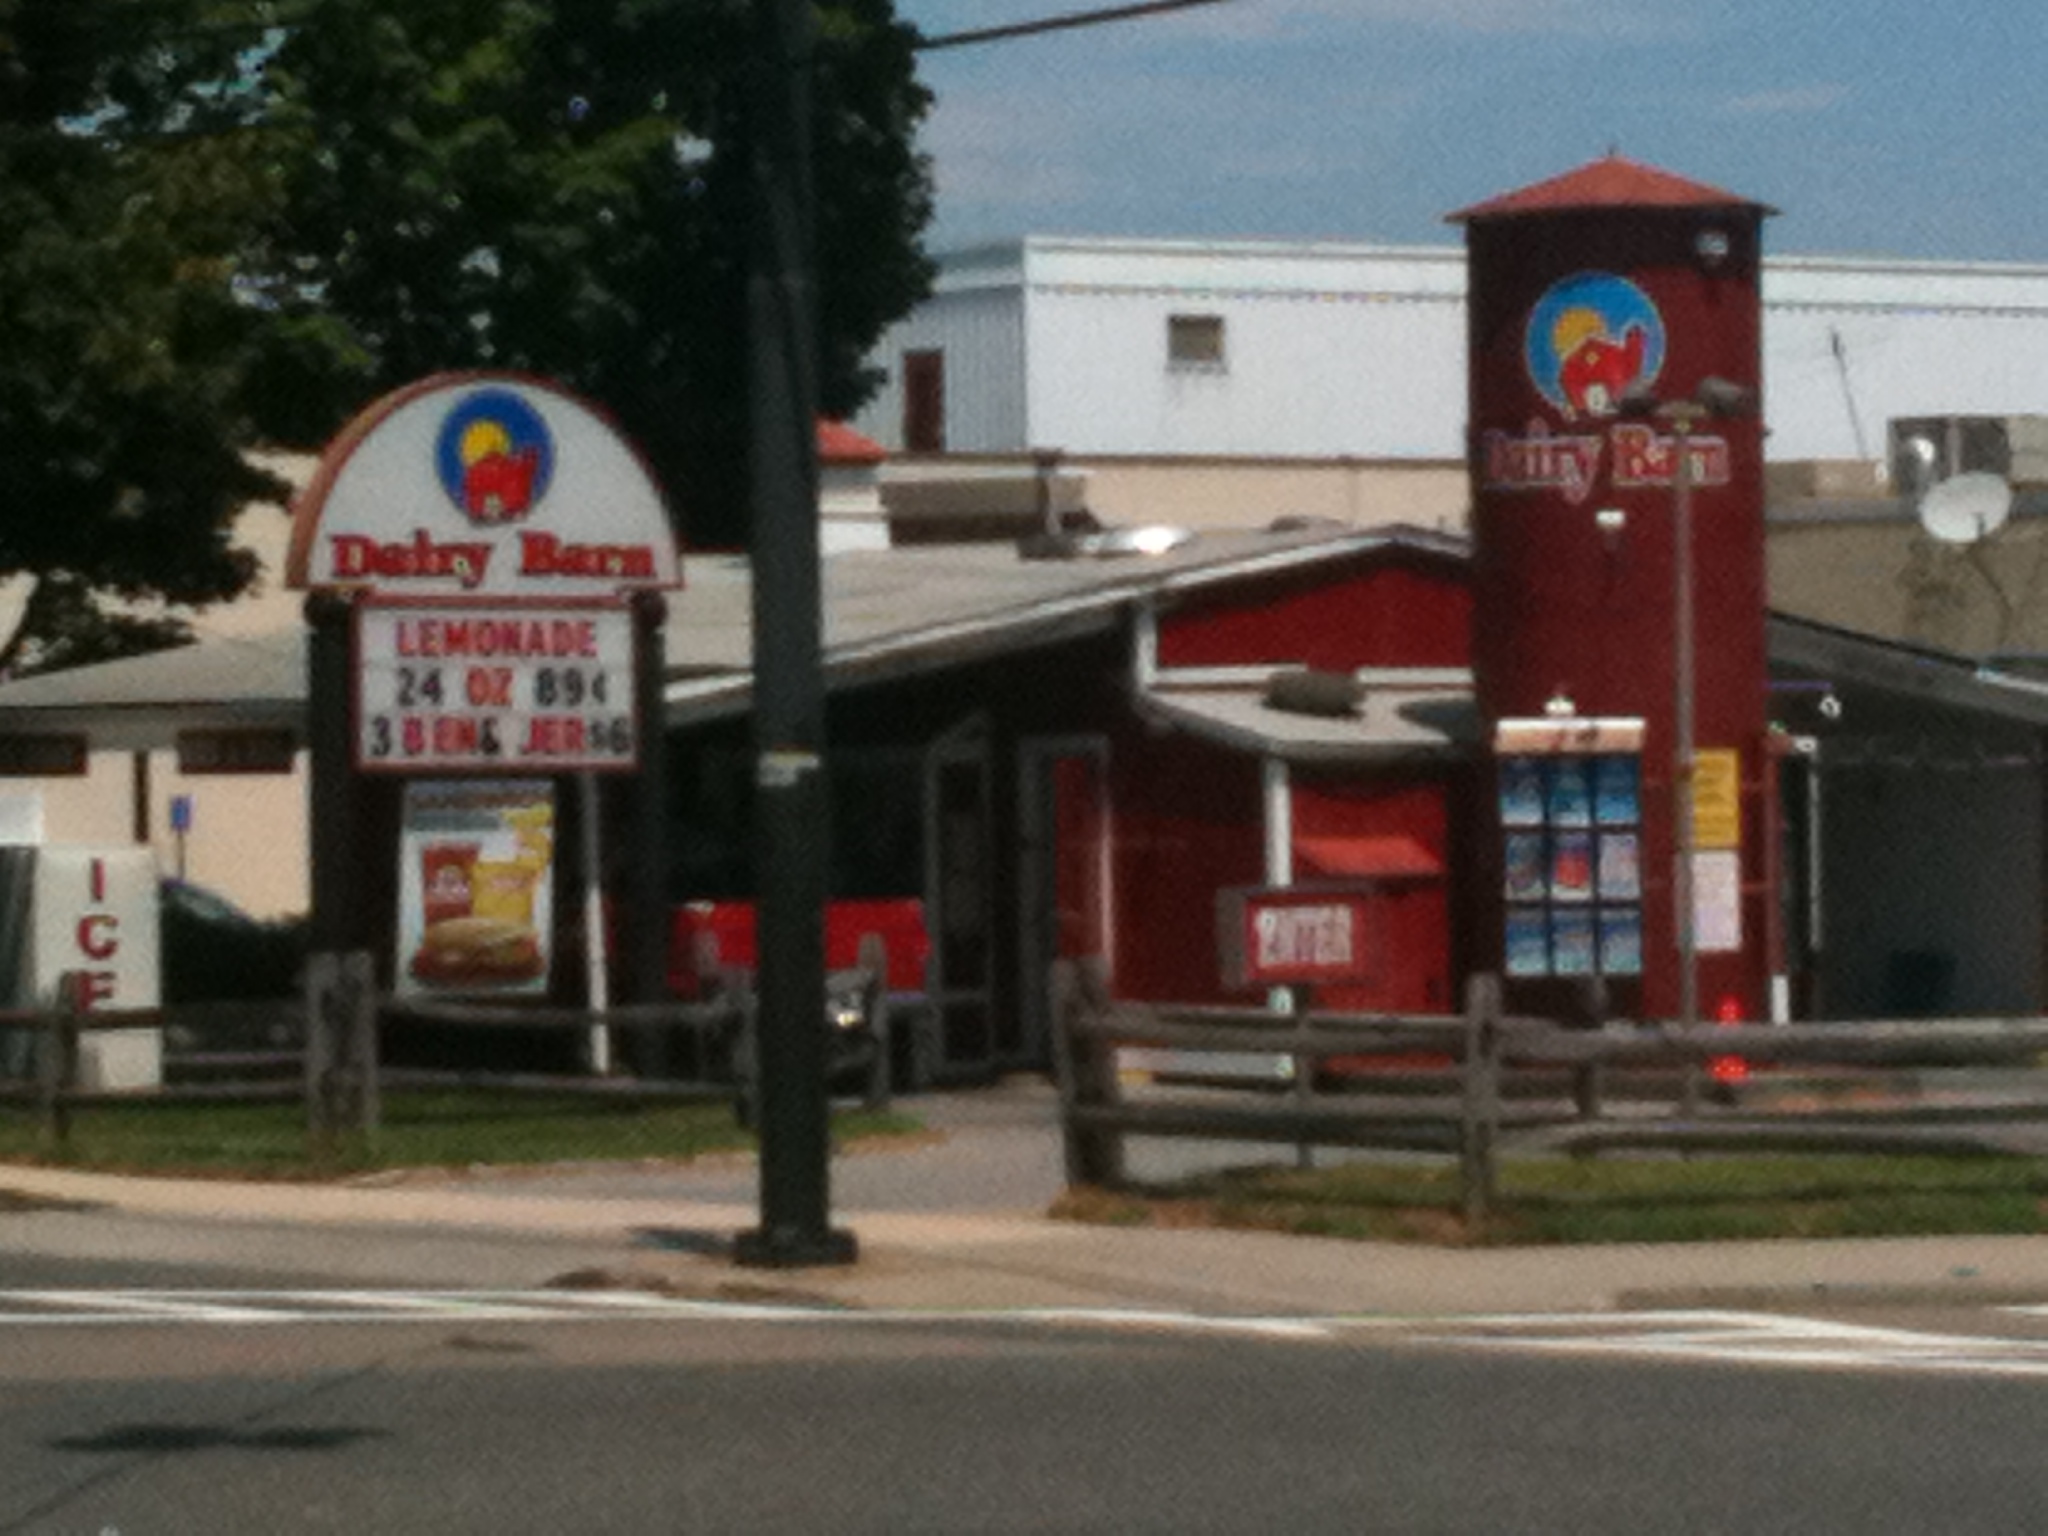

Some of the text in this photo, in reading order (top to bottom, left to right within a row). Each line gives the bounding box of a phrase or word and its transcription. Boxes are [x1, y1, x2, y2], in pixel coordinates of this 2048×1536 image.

[332, 528, 657, 588] Dairy Barn
[397, 620, 598, 658] LEMONADE
[399, 668, 443, 706] 24
[466, 667, 514, 707] OZ
[371, 715, 391, 757] 3
